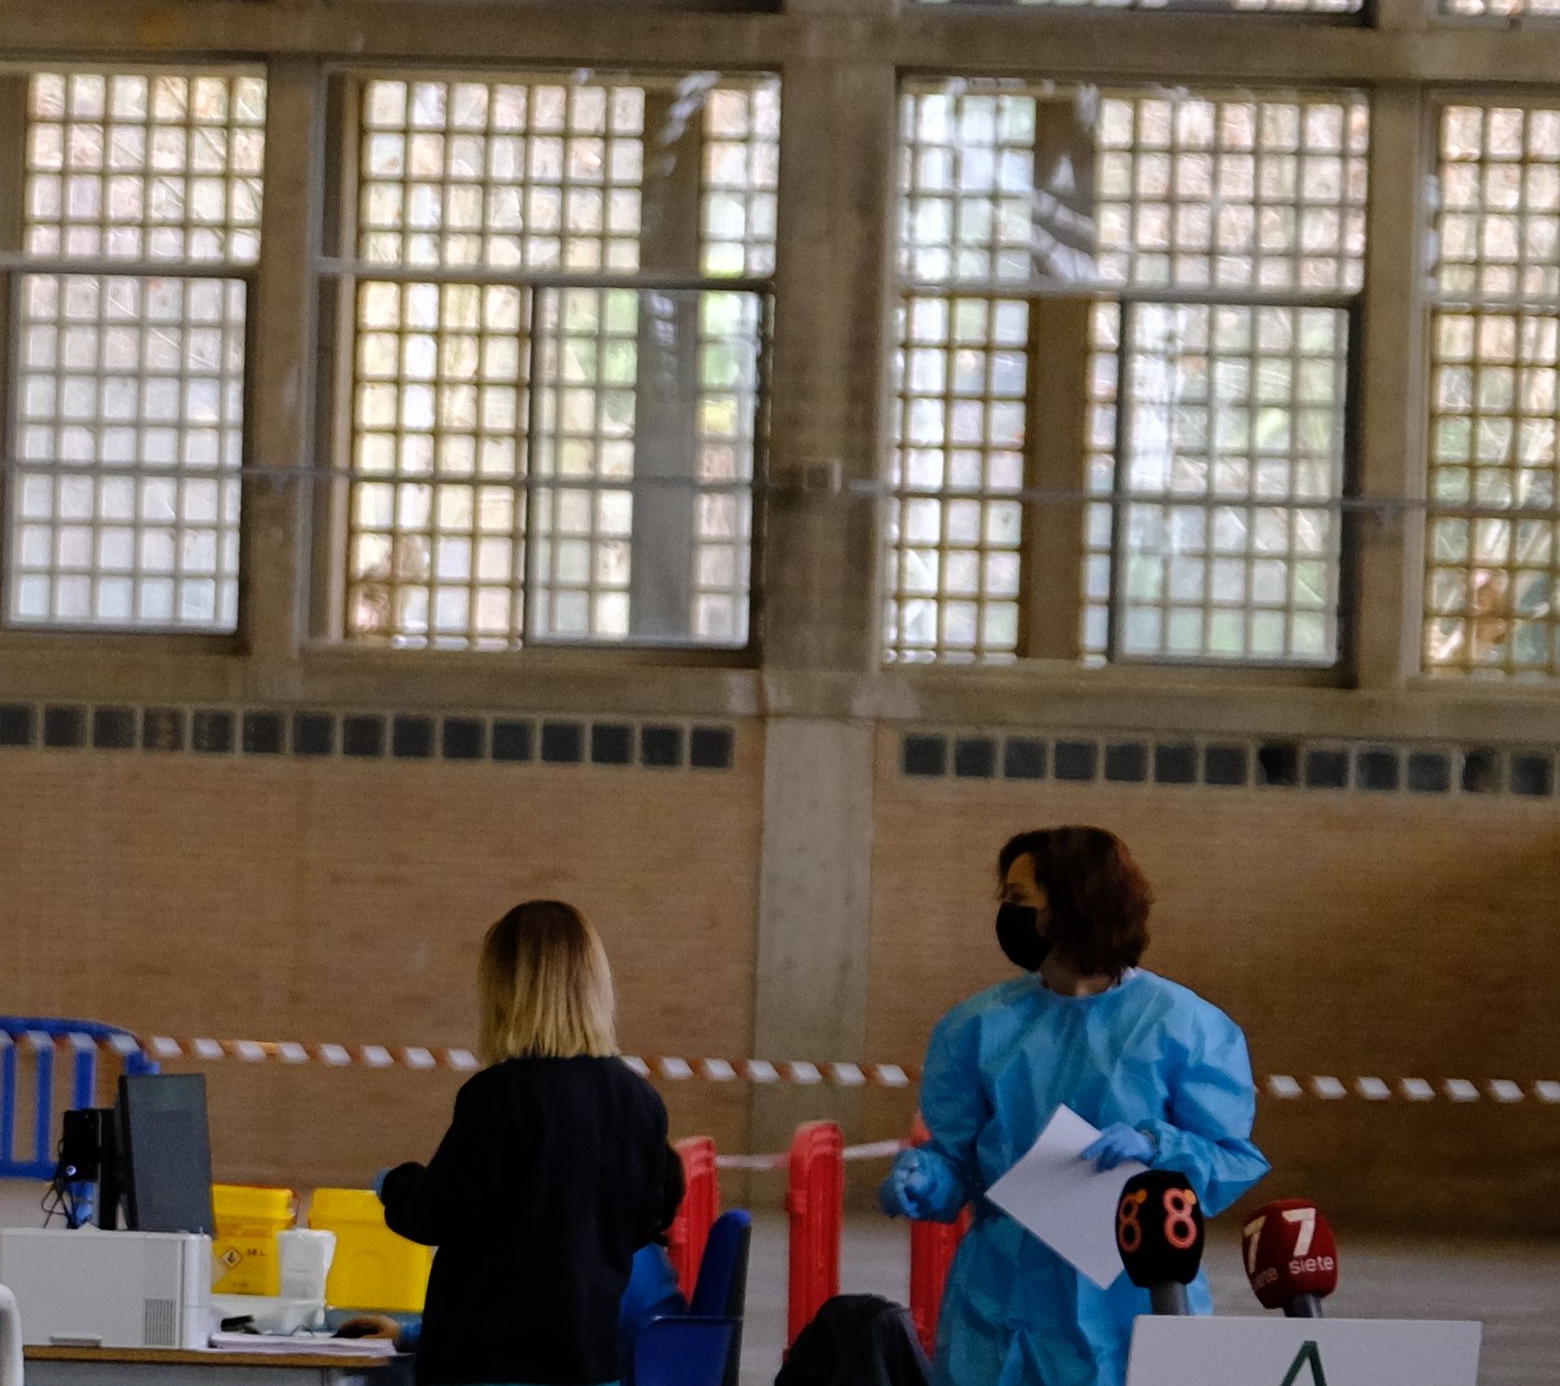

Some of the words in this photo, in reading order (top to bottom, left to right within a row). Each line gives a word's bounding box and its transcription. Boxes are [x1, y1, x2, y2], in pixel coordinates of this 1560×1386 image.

[1163, 1187, 1198, 1249] 8
[1282, 1207, 1316, 1257] 7
[1289, 1255, 1334, 1274] siete
